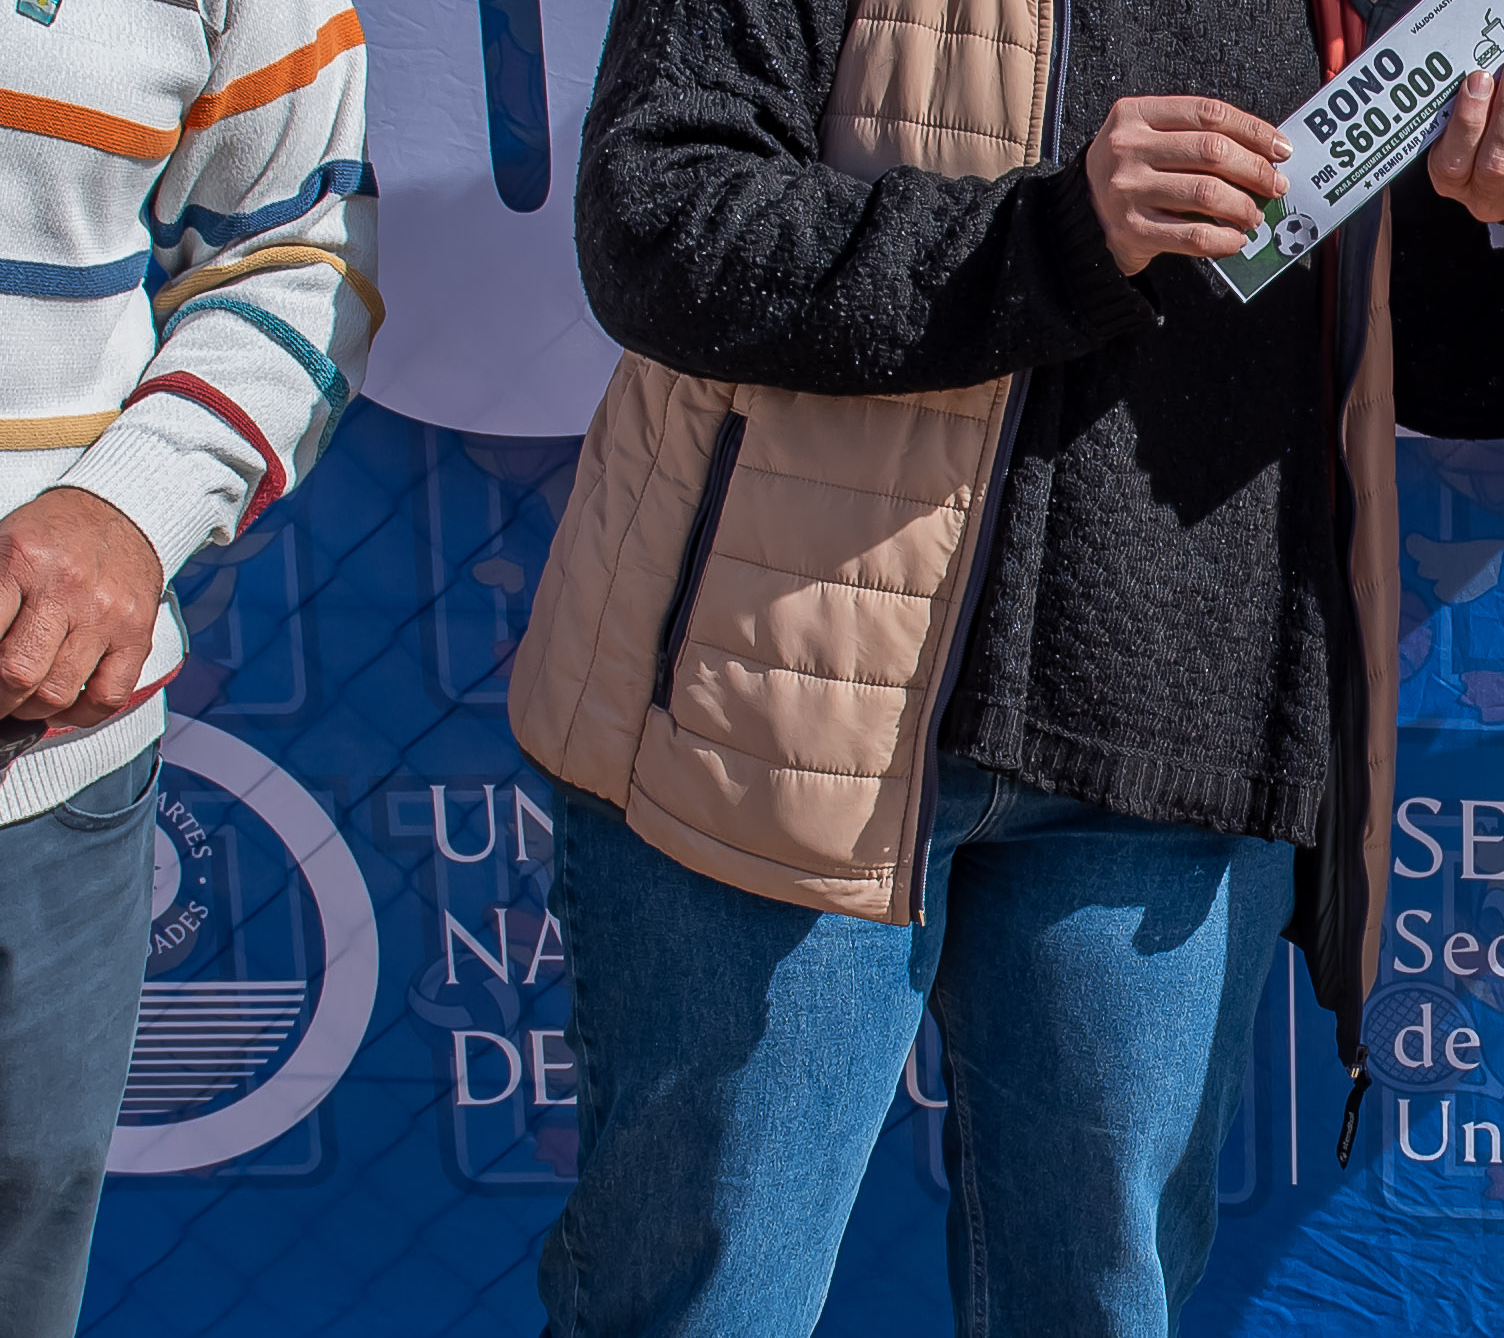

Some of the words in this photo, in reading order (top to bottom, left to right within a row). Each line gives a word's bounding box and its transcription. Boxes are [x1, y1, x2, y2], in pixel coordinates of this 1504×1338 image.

[1410, 11, 1434, 34] VÁLIDO
[1303, 48, 1404, 145] BONO
[1310, 164, 1338, 190] POR
[1328, 51, 1454, 169] $60.000
[1334, 179, 1353, 196] PARA
[1349, 151, 1382, 181] CONSUMIR
[1381, 142, 1392, 155] EN
[1390, 136, 1400, 147] EL
[1398, 116, 1422, 139] BUFFET
[1419, 105, 1434, 120] DEL
[1372, 151, 1404, 182] PREMIO
[1400, 134, 1424, 156] FAIR
[1419, 116, 1443, 141] PLAY
[452, 1030, 578, 1106] DE
[1393, 1002, 1481, 1071] de
